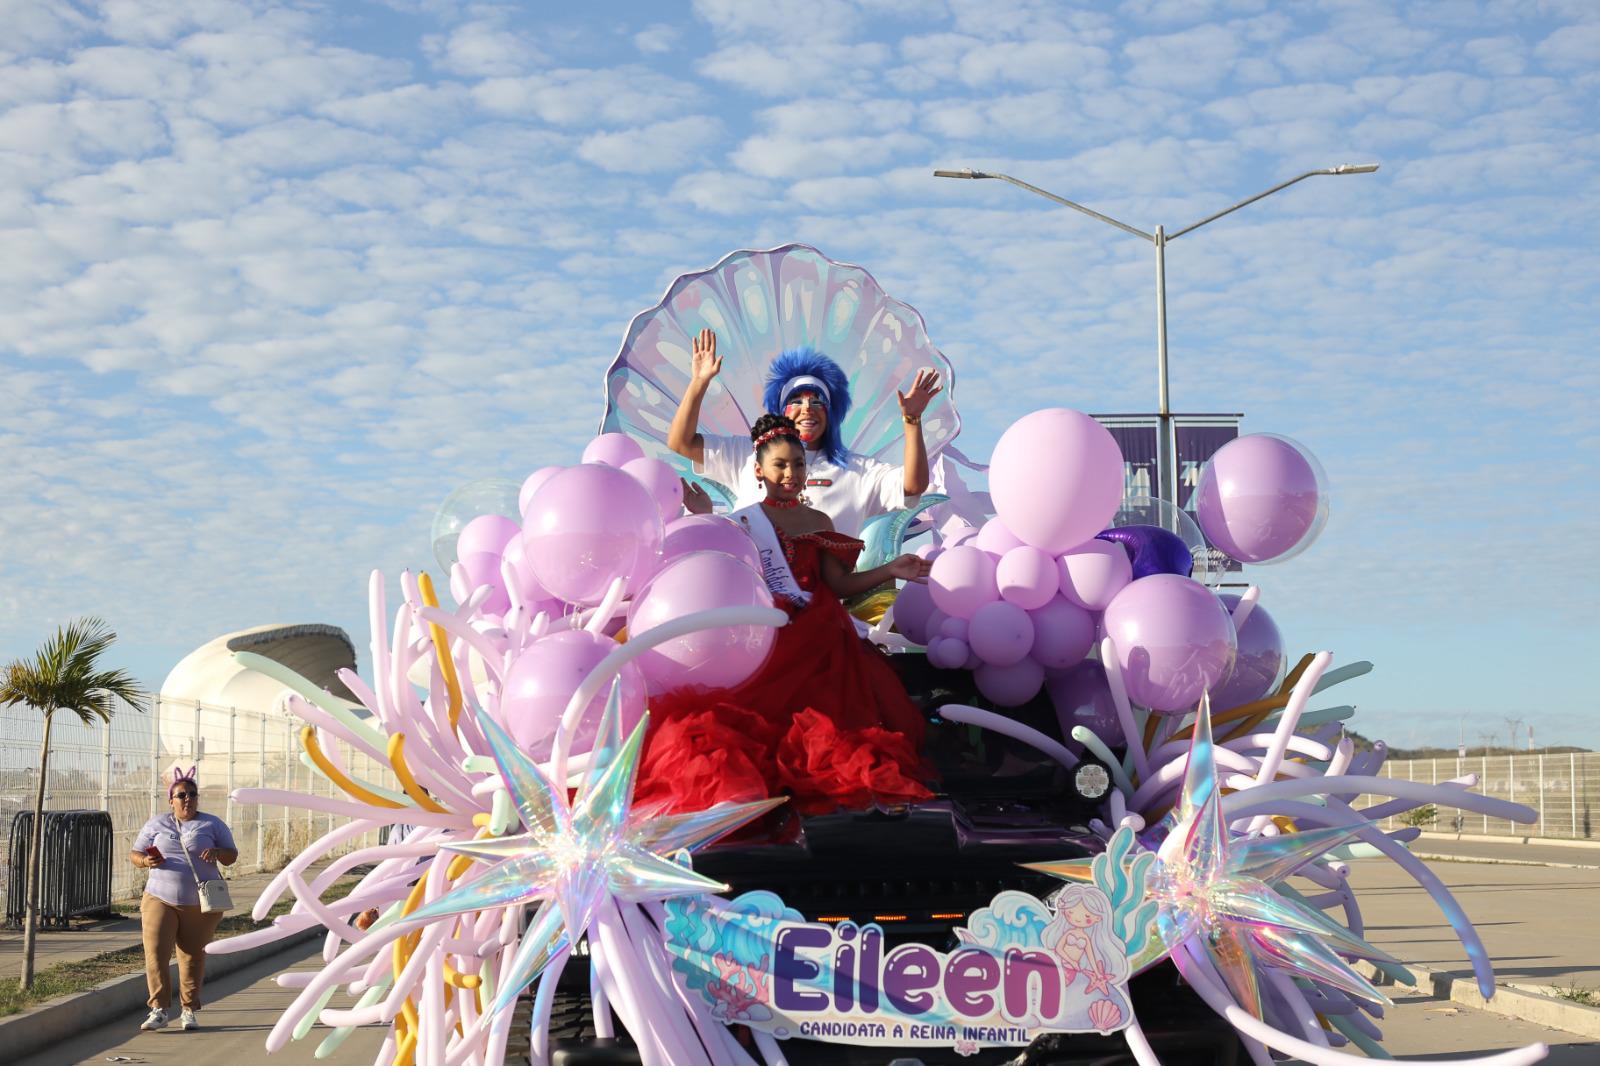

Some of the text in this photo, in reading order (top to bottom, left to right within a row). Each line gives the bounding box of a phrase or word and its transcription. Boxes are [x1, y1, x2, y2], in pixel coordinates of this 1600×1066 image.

[774, 922, 1061, 1019] Eileen
[799, 1021, 1031, 1042] CANDIDATA A REINA INFANTIL
